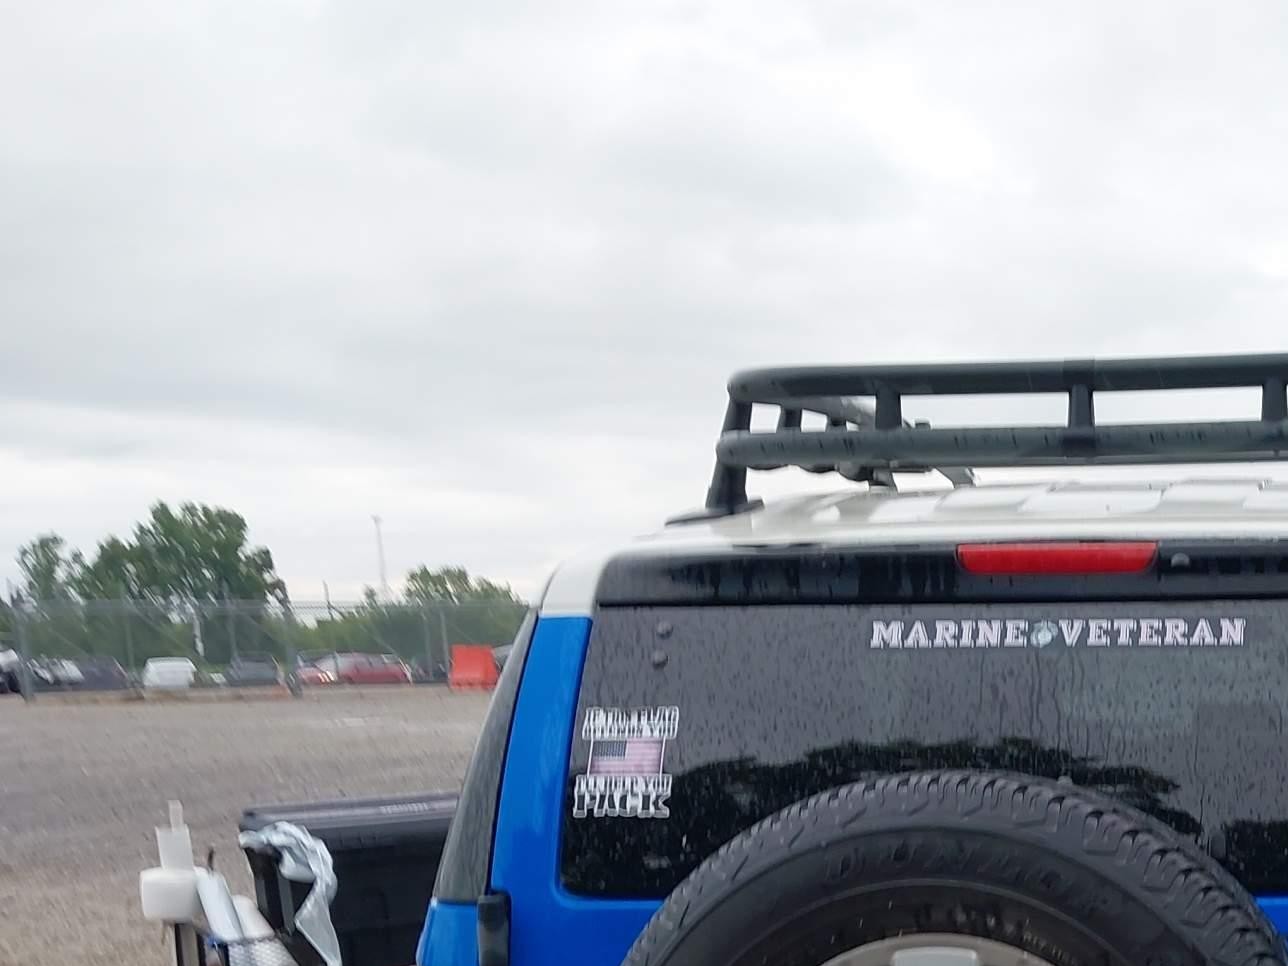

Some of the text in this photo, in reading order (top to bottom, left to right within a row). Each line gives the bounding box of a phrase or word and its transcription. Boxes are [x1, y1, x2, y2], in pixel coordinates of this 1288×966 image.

[870, 617, 1248, 649] MARINE VETERAN
[573, 791, 670, 818] PACK
